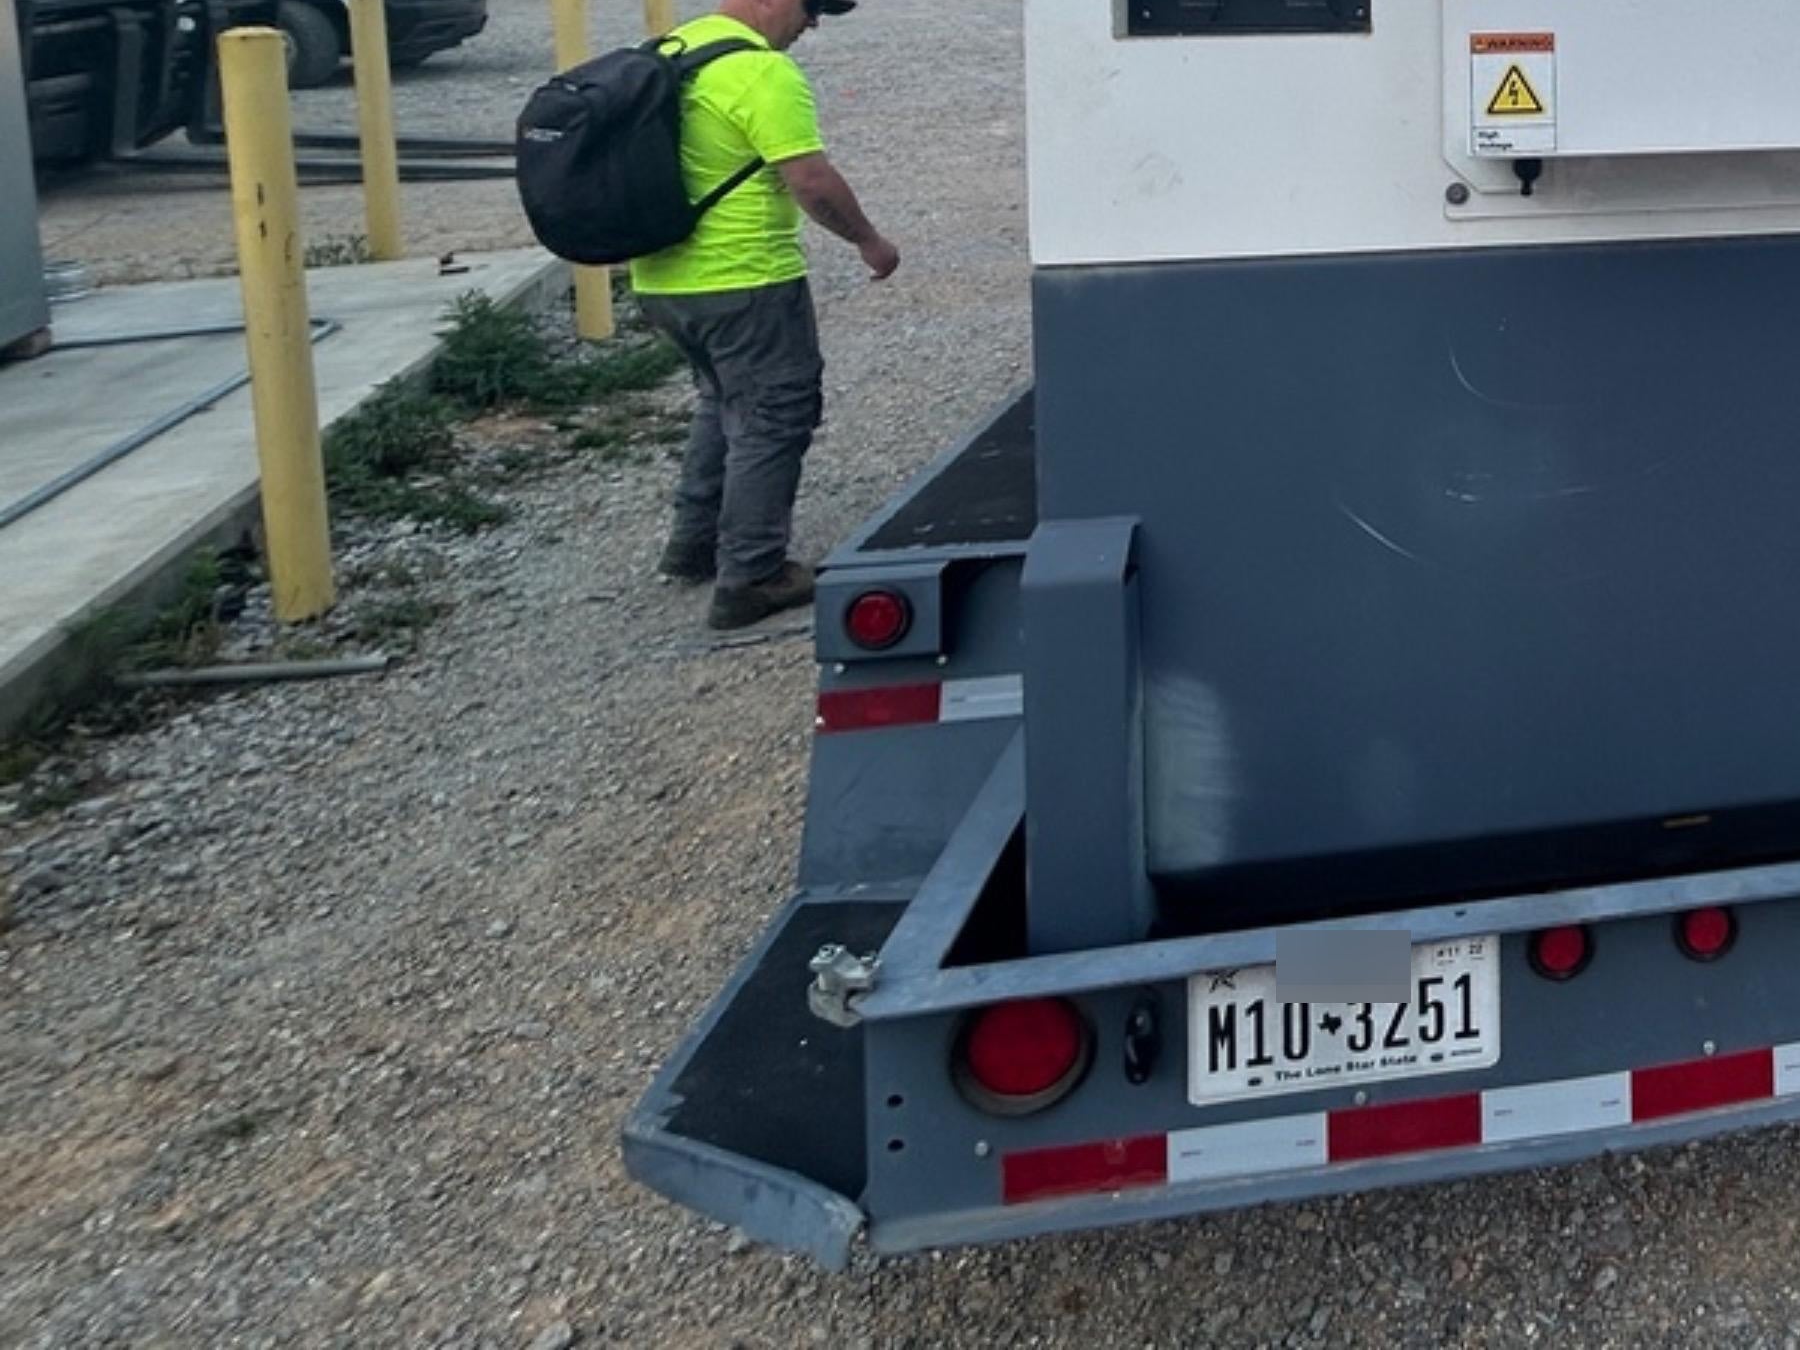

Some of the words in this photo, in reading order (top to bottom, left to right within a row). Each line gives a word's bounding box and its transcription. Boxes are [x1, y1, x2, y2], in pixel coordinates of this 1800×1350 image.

[1274, 1069, 1301, 1082] The
[1305, 1064, 1341, 1078] Lone
[1346, 1059, 1375, 1072] Star
[1380, 1053, 1417, 1068] State
